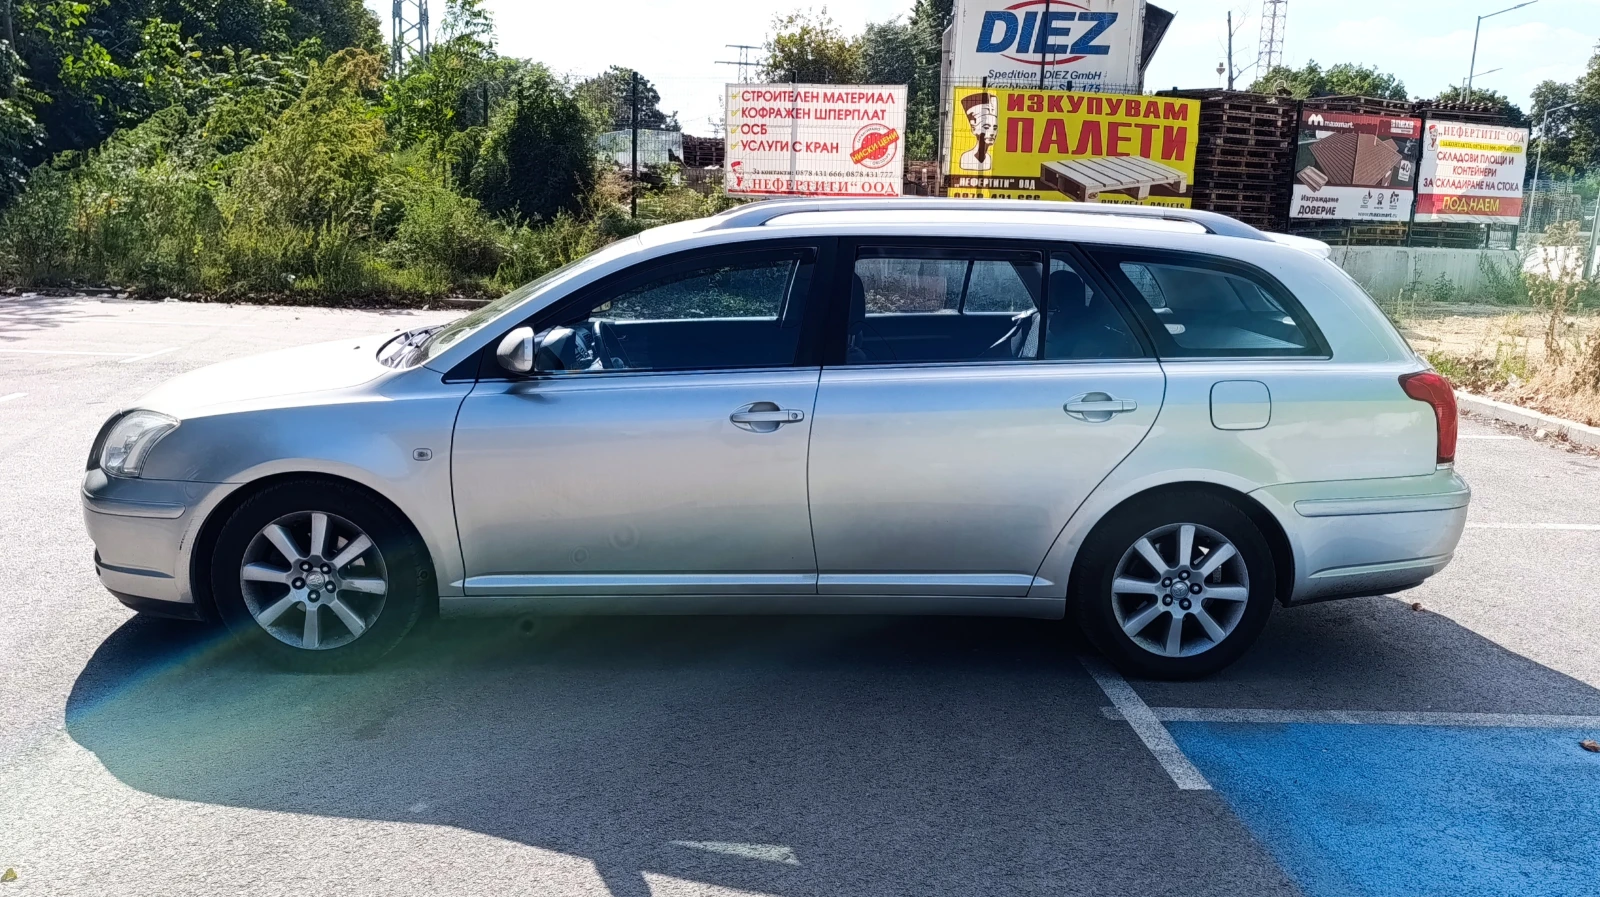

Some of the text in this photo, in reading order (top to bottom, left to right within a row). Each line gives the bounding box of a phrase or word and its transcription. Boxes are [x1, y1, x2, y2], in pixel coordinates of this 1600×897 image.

[976, 10, 1118, 56] DIEZ
[988, 70, 1102, 80] Spedition DIEZ GmbH
[1082, 84, 1100, 92] 175
[742, 90, 895, 104] СТРОИТЕЛЕН МАТЕРИАЛ
[741, 106, 886, 120] КОФРАЖЕН ШПЕРПЛАТ
[1007, 93, 1188, 121] ИЗКУПУВАМ
[741, 124, 767, 135] ОСБ
[1005, 117, 1187, 161] ПАЛЕТИ
[1506, 130, 1524, 143] ООД
[741, 140, 789, 152] УСЛУГИ
[806, 142, 839, 154] КРАН
[852, 142, 878, 163] НИСКИ
[878, 131, 898, 147] ЦЕНИ
[1437, 151, 1514, 166] СКЛАДОВИ ПЛОЩИ И
[1453, 165, 1496, 177] КОНТЕЙНЕРИ
[862, 182, 896, 194] ООД
[1019, 179, 1035, 189] ООД
[1424, 178, 1519, 191] ЗА СКЛАДИРАНЕ НА СТОКА
[1298, 205, 1336, 216] ДОВЕРИЕ
[1442, 196, 1499, 212] ПОД НАЕМ
